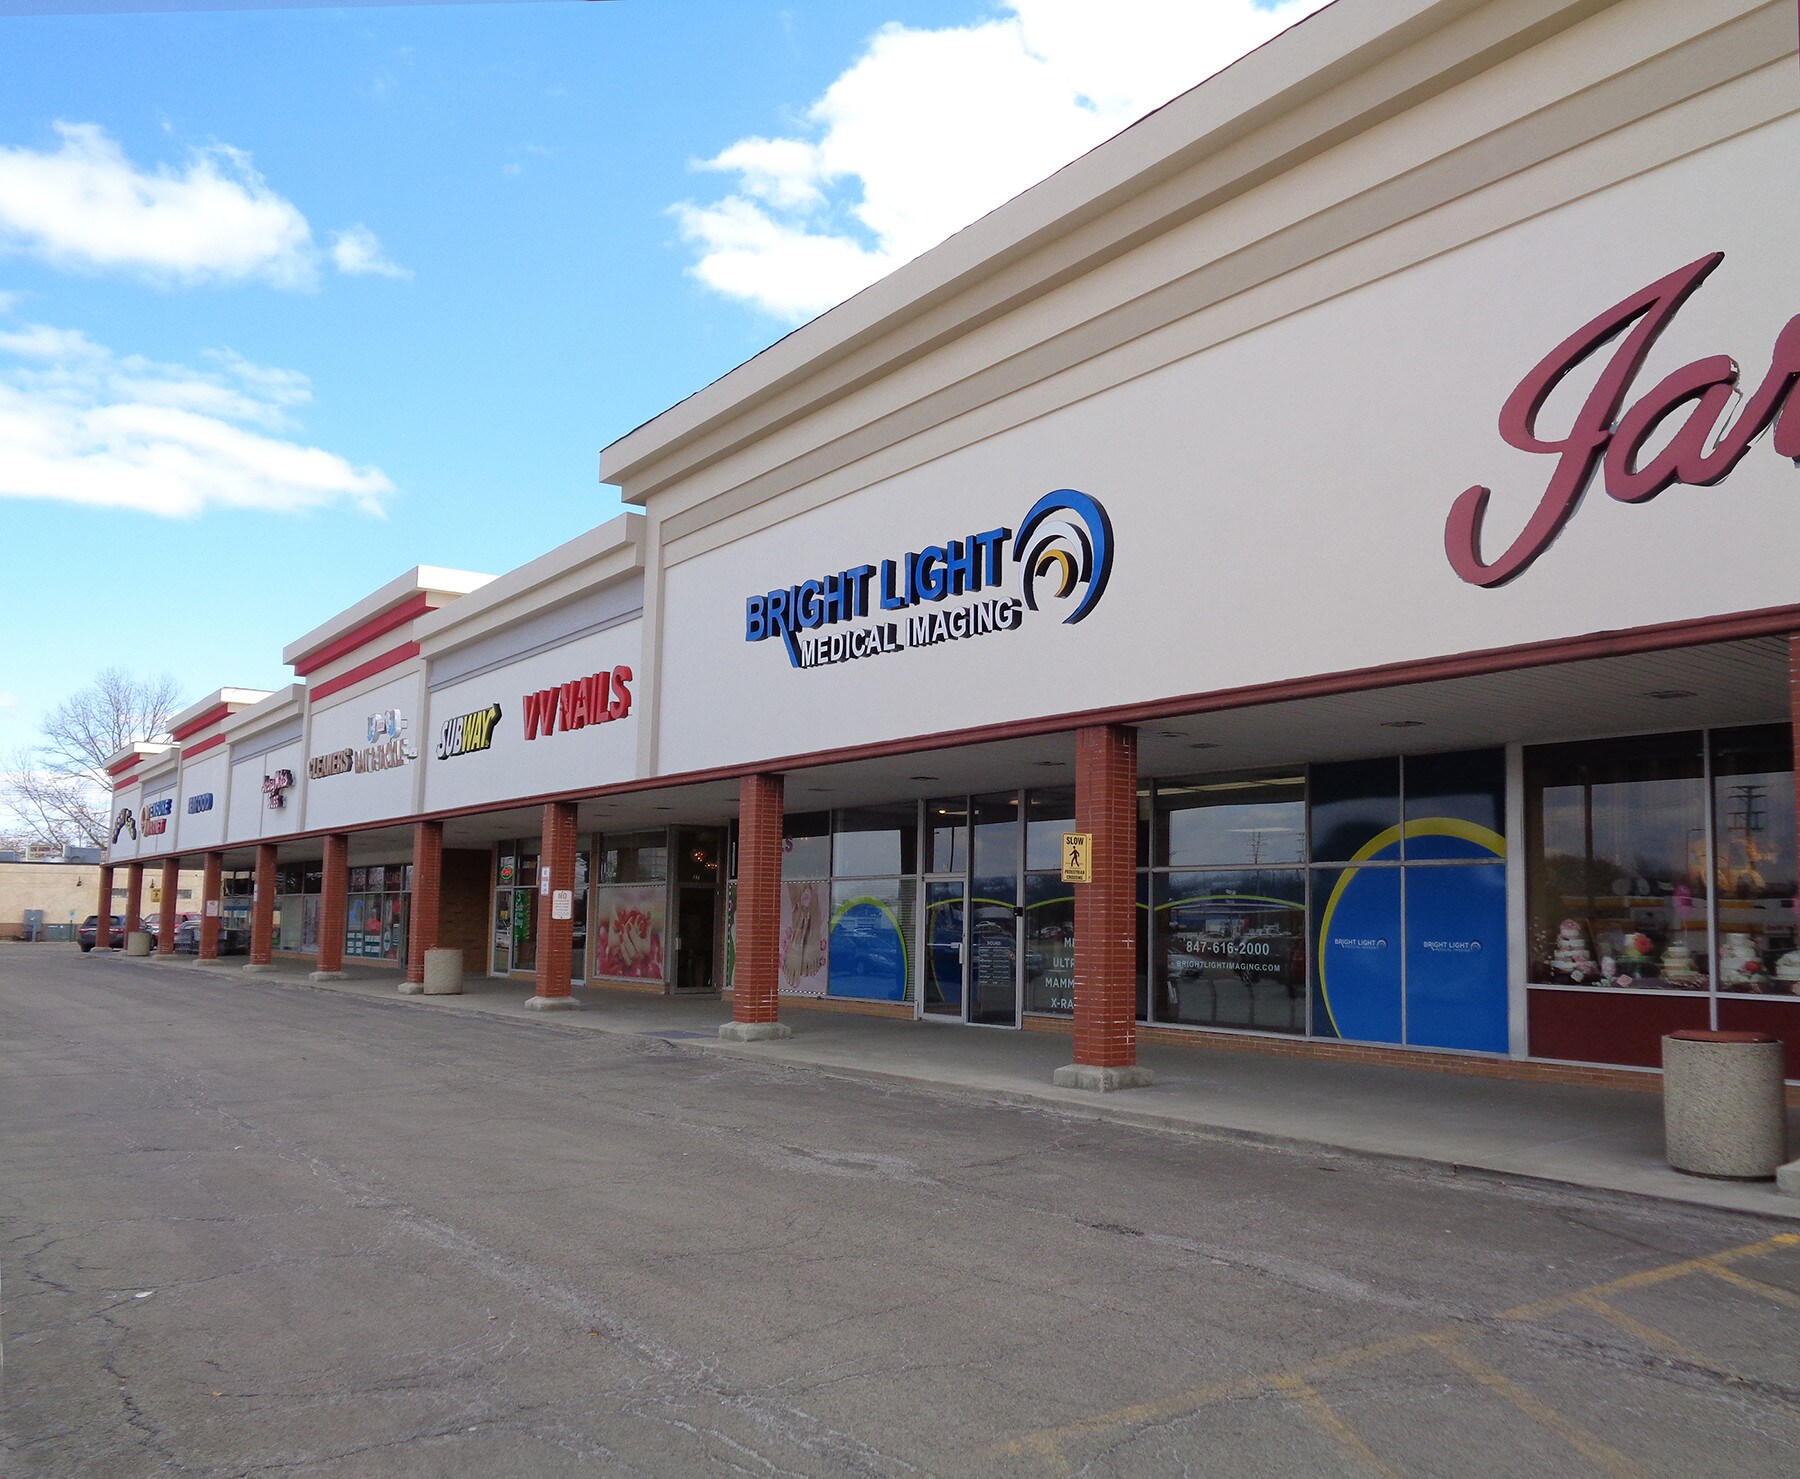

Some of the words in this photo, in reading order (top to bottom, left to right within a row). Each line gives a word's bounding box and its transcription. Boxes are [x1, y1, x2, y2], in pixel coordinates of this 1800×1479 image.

[746, 564, 876, 668] BRIGHT
[879, 527, 1012, 610] LIGHT
[800, 622, 904, 668] MEDICAL
[905, 597, 1022, 648] IMAGING
[558, 665, 632, 732] NAILS
[436, 703, 502, 760] SUBWAY
[1066, 836, 1084, 845] SLOW
[1186, 940, 1270, 956] 847-616-2000
[1334, 939, 1356, 949] BRIGHT
[1423, 941, 1447, 951] BRIGHT
[1176, 960, 1281, 972] BRIGHTLIGHTIMAGING.COM
